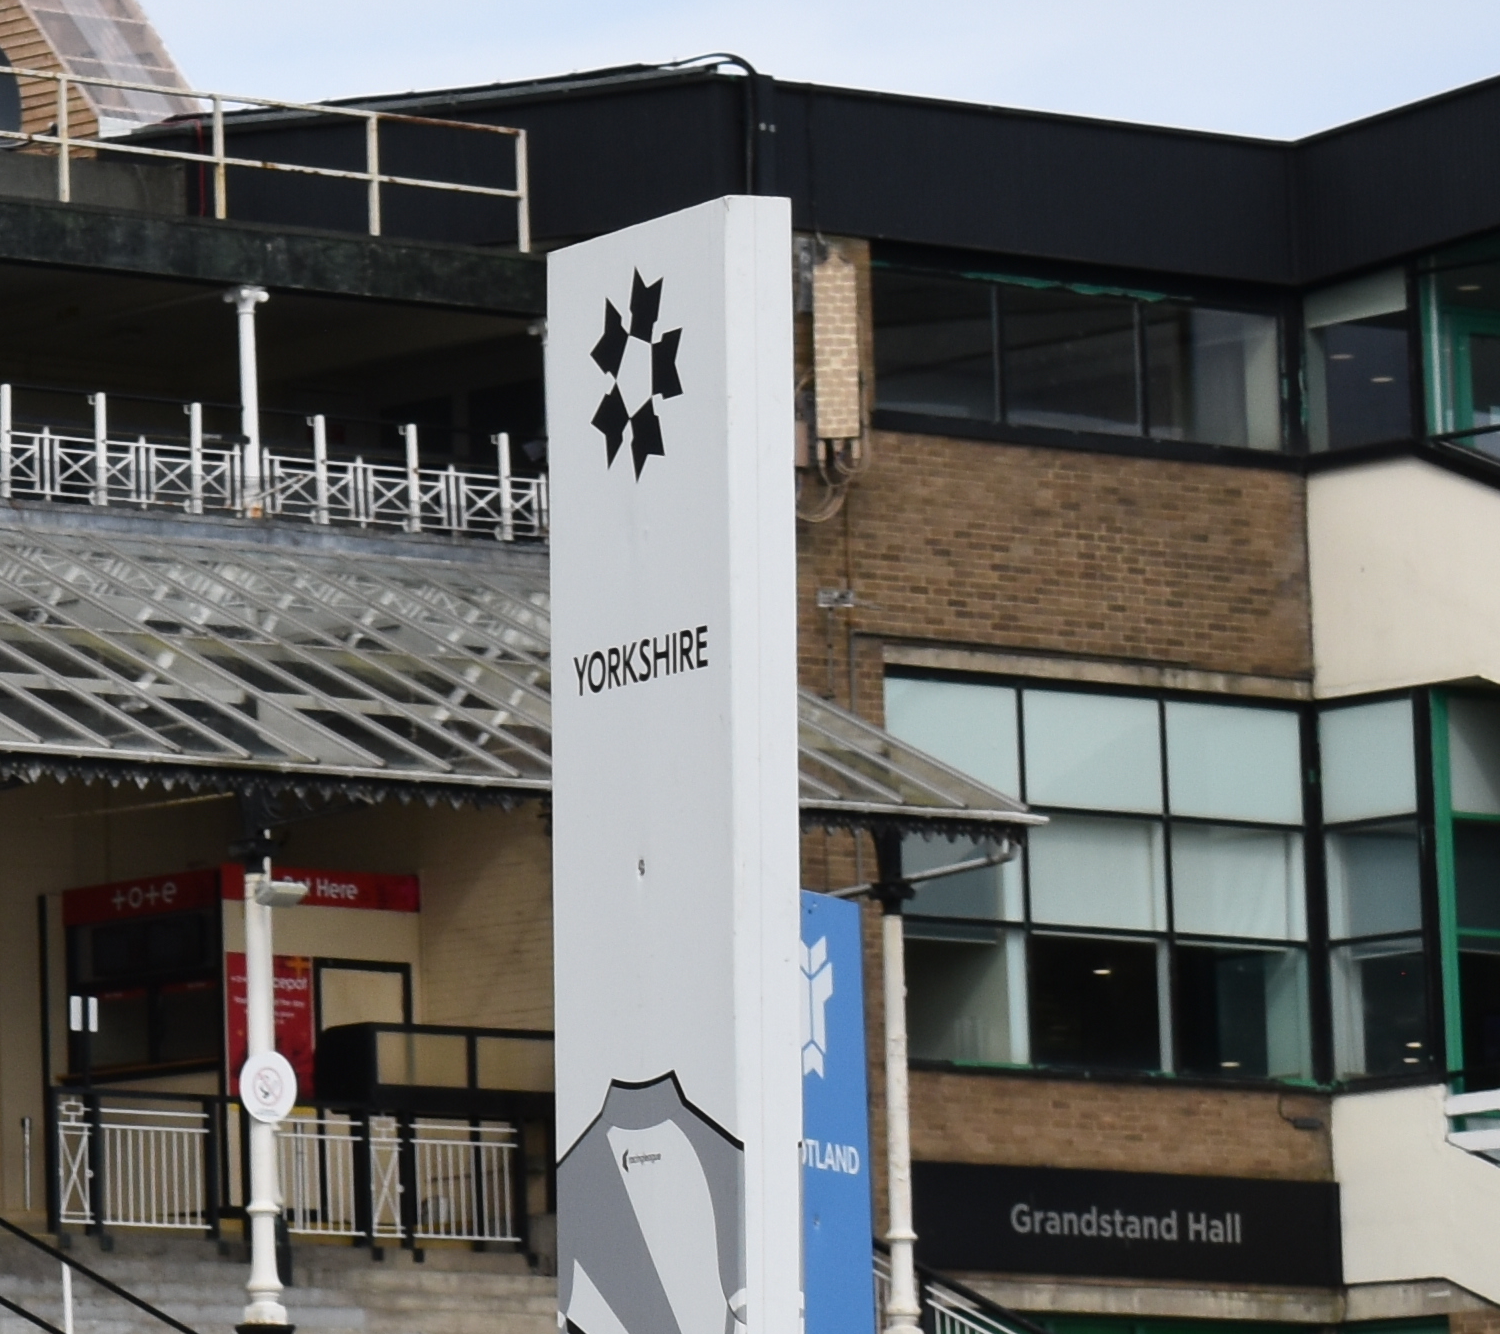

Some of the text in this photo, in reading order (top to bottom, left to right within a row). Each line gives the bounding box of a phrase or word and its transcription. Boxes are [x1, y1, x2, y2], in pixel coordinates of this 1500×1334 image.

[573, 625, 709, 697] YORKSHIRE
[316, 878, 359, 900] Here
[803, 1138, 860, 1175] TLAND
[1010, 1202, 1243, 1244] Grandstand Hall
